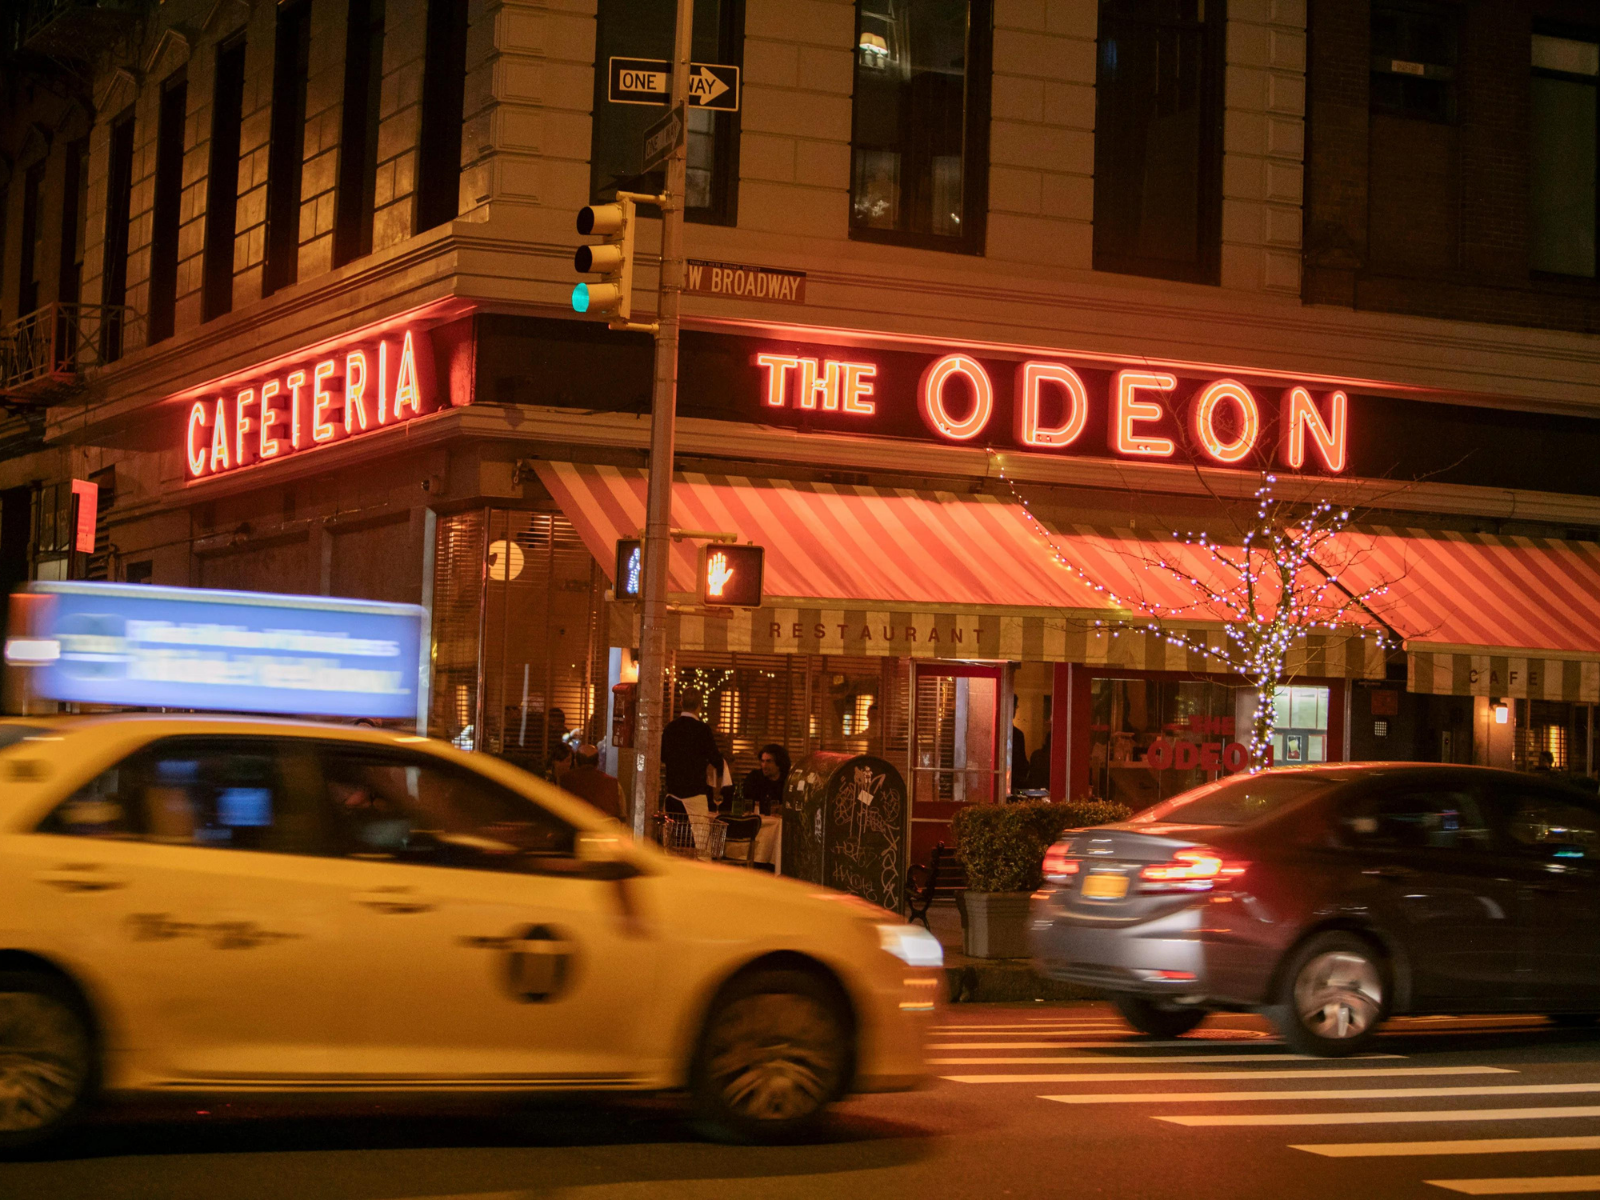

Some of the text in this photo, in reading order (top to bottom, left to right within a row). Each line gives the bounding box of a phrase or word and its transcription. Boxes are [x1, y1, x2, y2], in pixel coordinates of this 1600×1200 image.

[623, 72, 656, 90] ONE
[689, 265, 702, 290] W
[711, 268, 801, 300] BROADWAY
[187, 330, 421, 476] CAFETERIA
[757, 352, 1348, 472] THE ODEON
[769, 622, 984, 644] RESTAURANT
[1469, 669, 1538, 686] CAFE
[1188, 714, 1236, 735] THE
